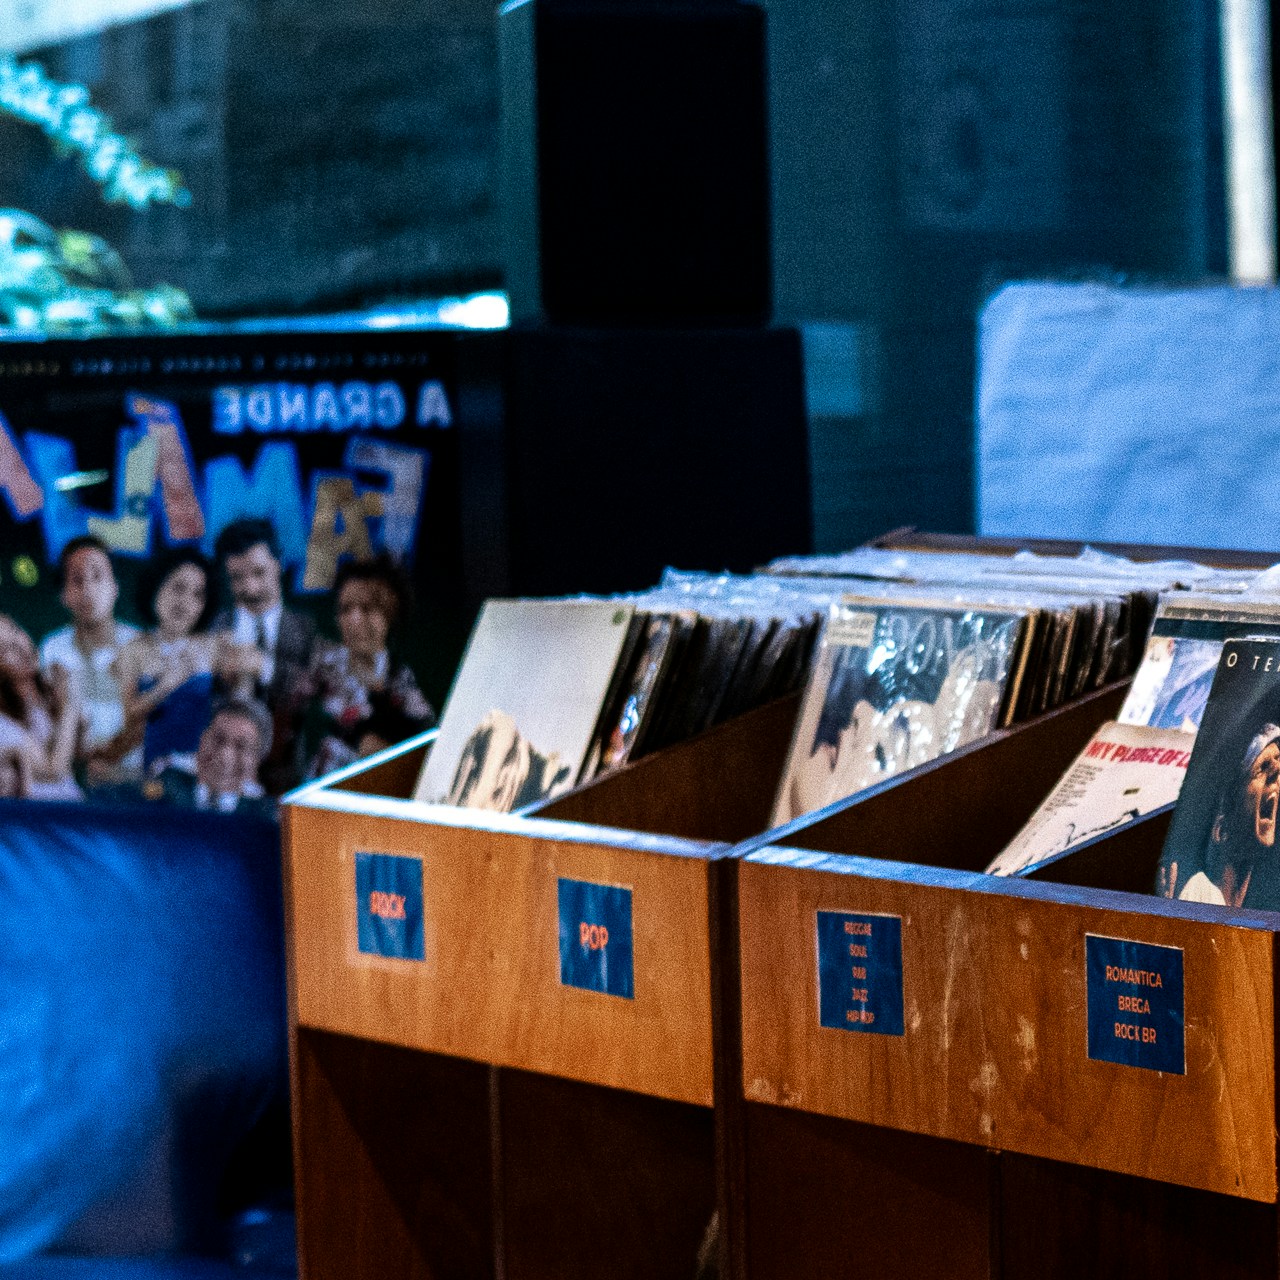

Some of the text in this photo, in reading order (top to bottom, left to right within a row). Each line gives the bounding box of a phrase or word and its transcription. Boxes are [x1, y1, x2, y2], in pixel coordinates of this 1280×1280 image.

[1227, 652, 1238, 668] O
[1085, 741, 1115, 760] MY
[1110, 744, 1165, 764] PLEDGE
[1157, 749, 1184, 766] OF
[369, 891, 406, 920] ROCK
[579, 922, 609, 950] POP
[1117, 995, 1151, 1015] BREGA
[1114, 1022, 1157, 1044] ROCK BR
